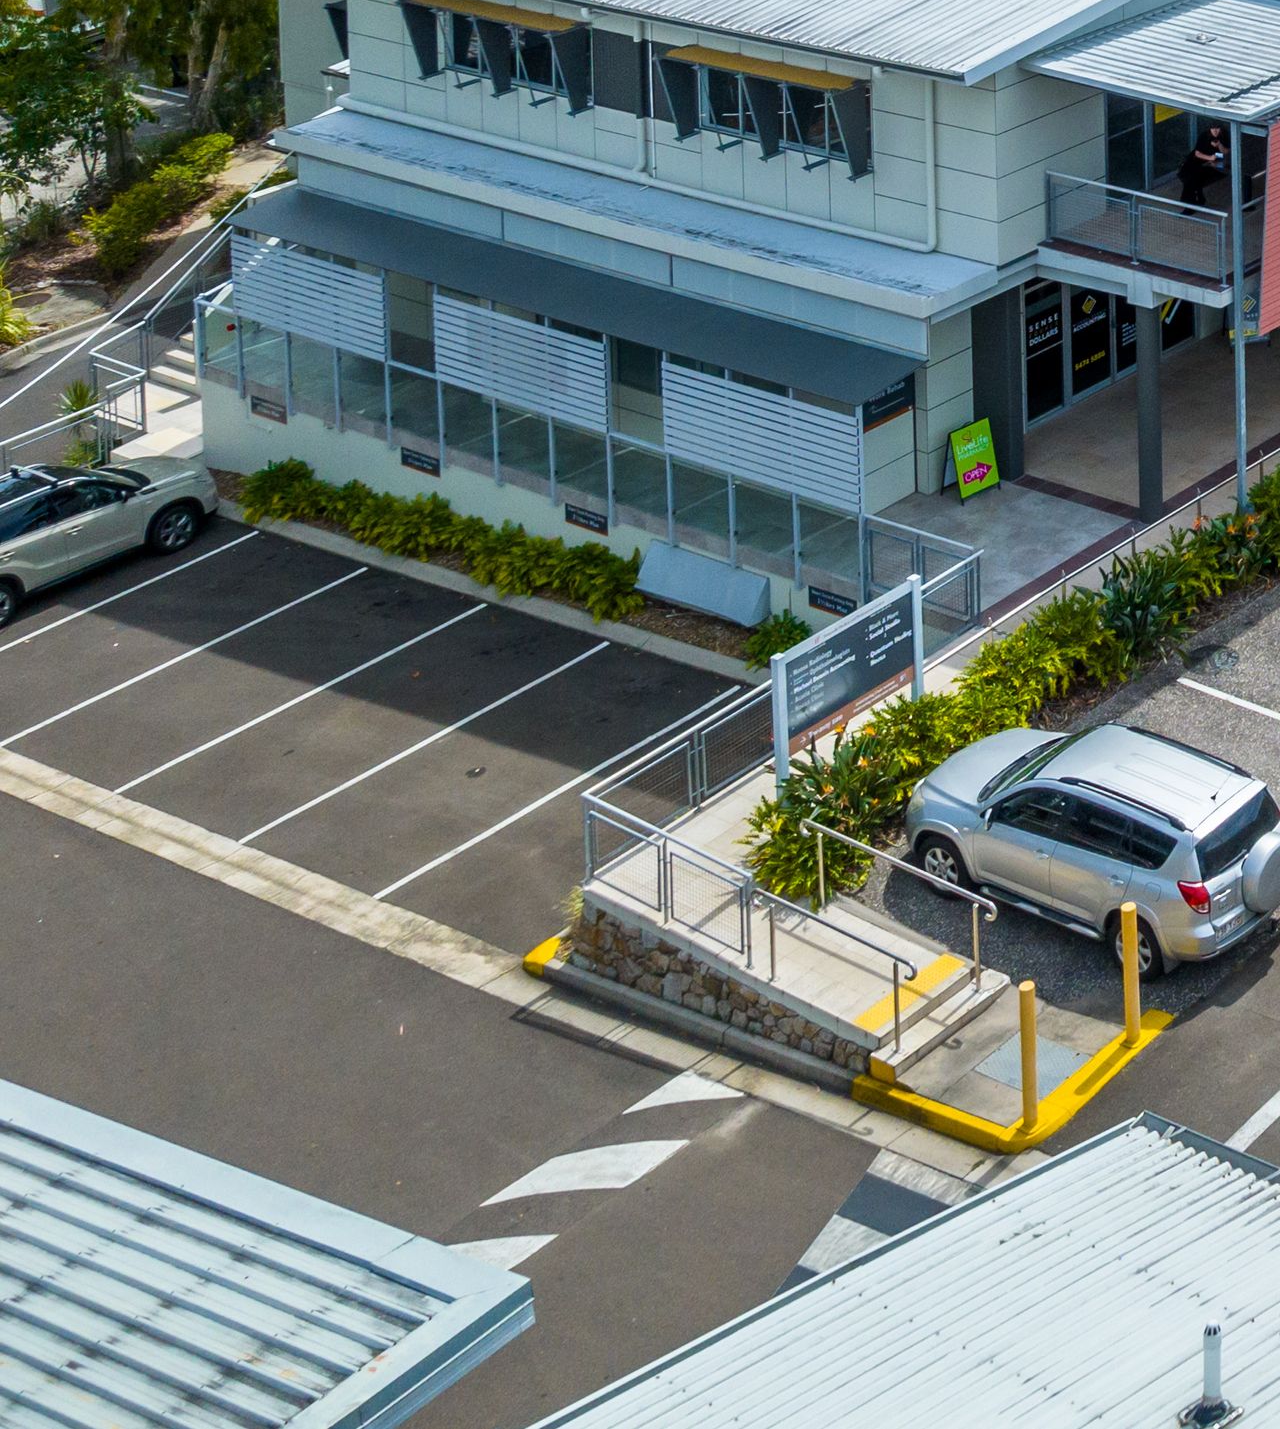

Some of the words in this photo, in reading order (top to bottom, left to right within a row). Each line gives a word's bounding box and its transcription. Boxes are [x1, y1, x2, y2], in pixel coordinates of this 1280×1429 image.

[1028, 313, 1059, 332] SENSE
[1073, 312, 1106, 332] ACCOUNTING
[1029, 326, 1059, 347] DOLLARS
[956, 434, 989, 455] LiveLife
[965, 466, 987, 482] OPEN
